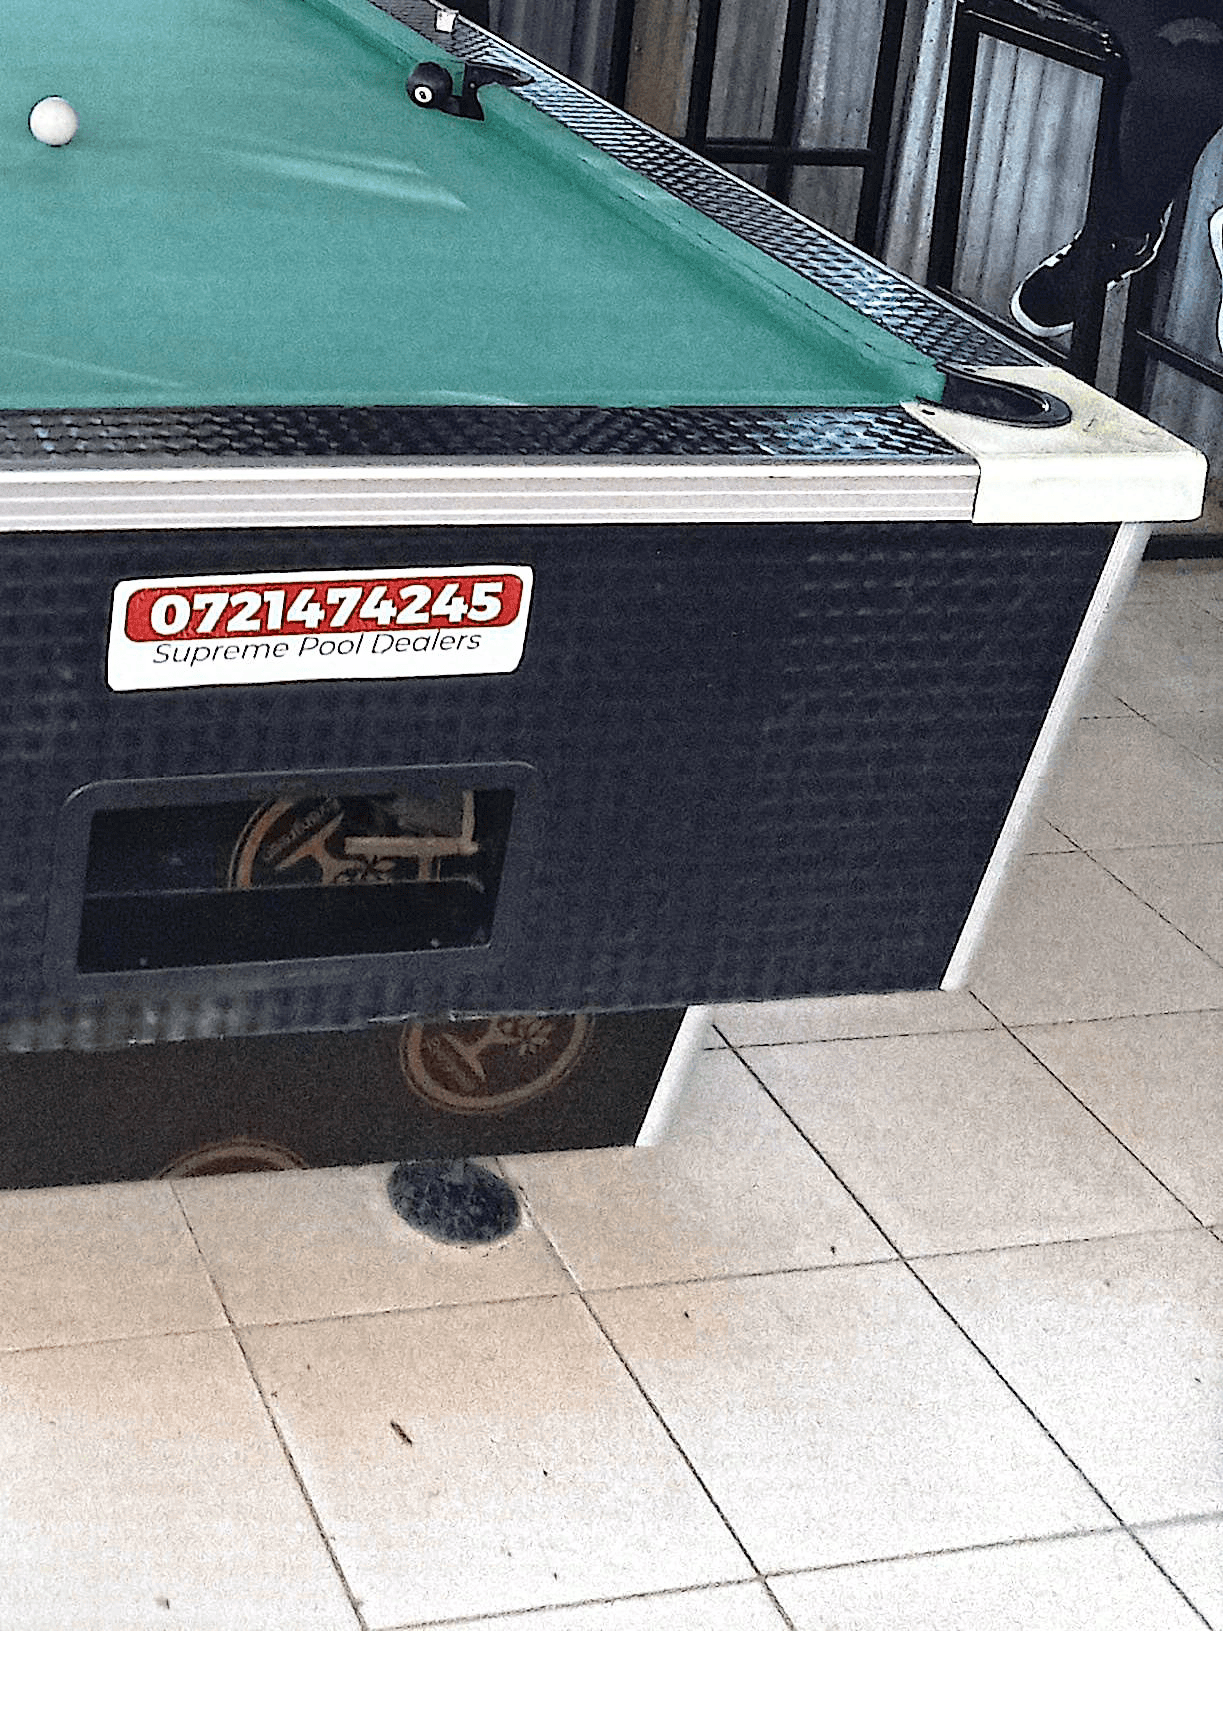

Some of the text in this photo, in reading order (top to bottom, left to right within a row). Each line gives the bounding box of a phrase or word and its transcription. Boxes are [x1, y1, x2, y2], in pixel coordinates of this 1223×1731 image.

[150, 581, 504, 636] 0721474245
[152, 628, 482, 668] Supreme Pool Dealers
